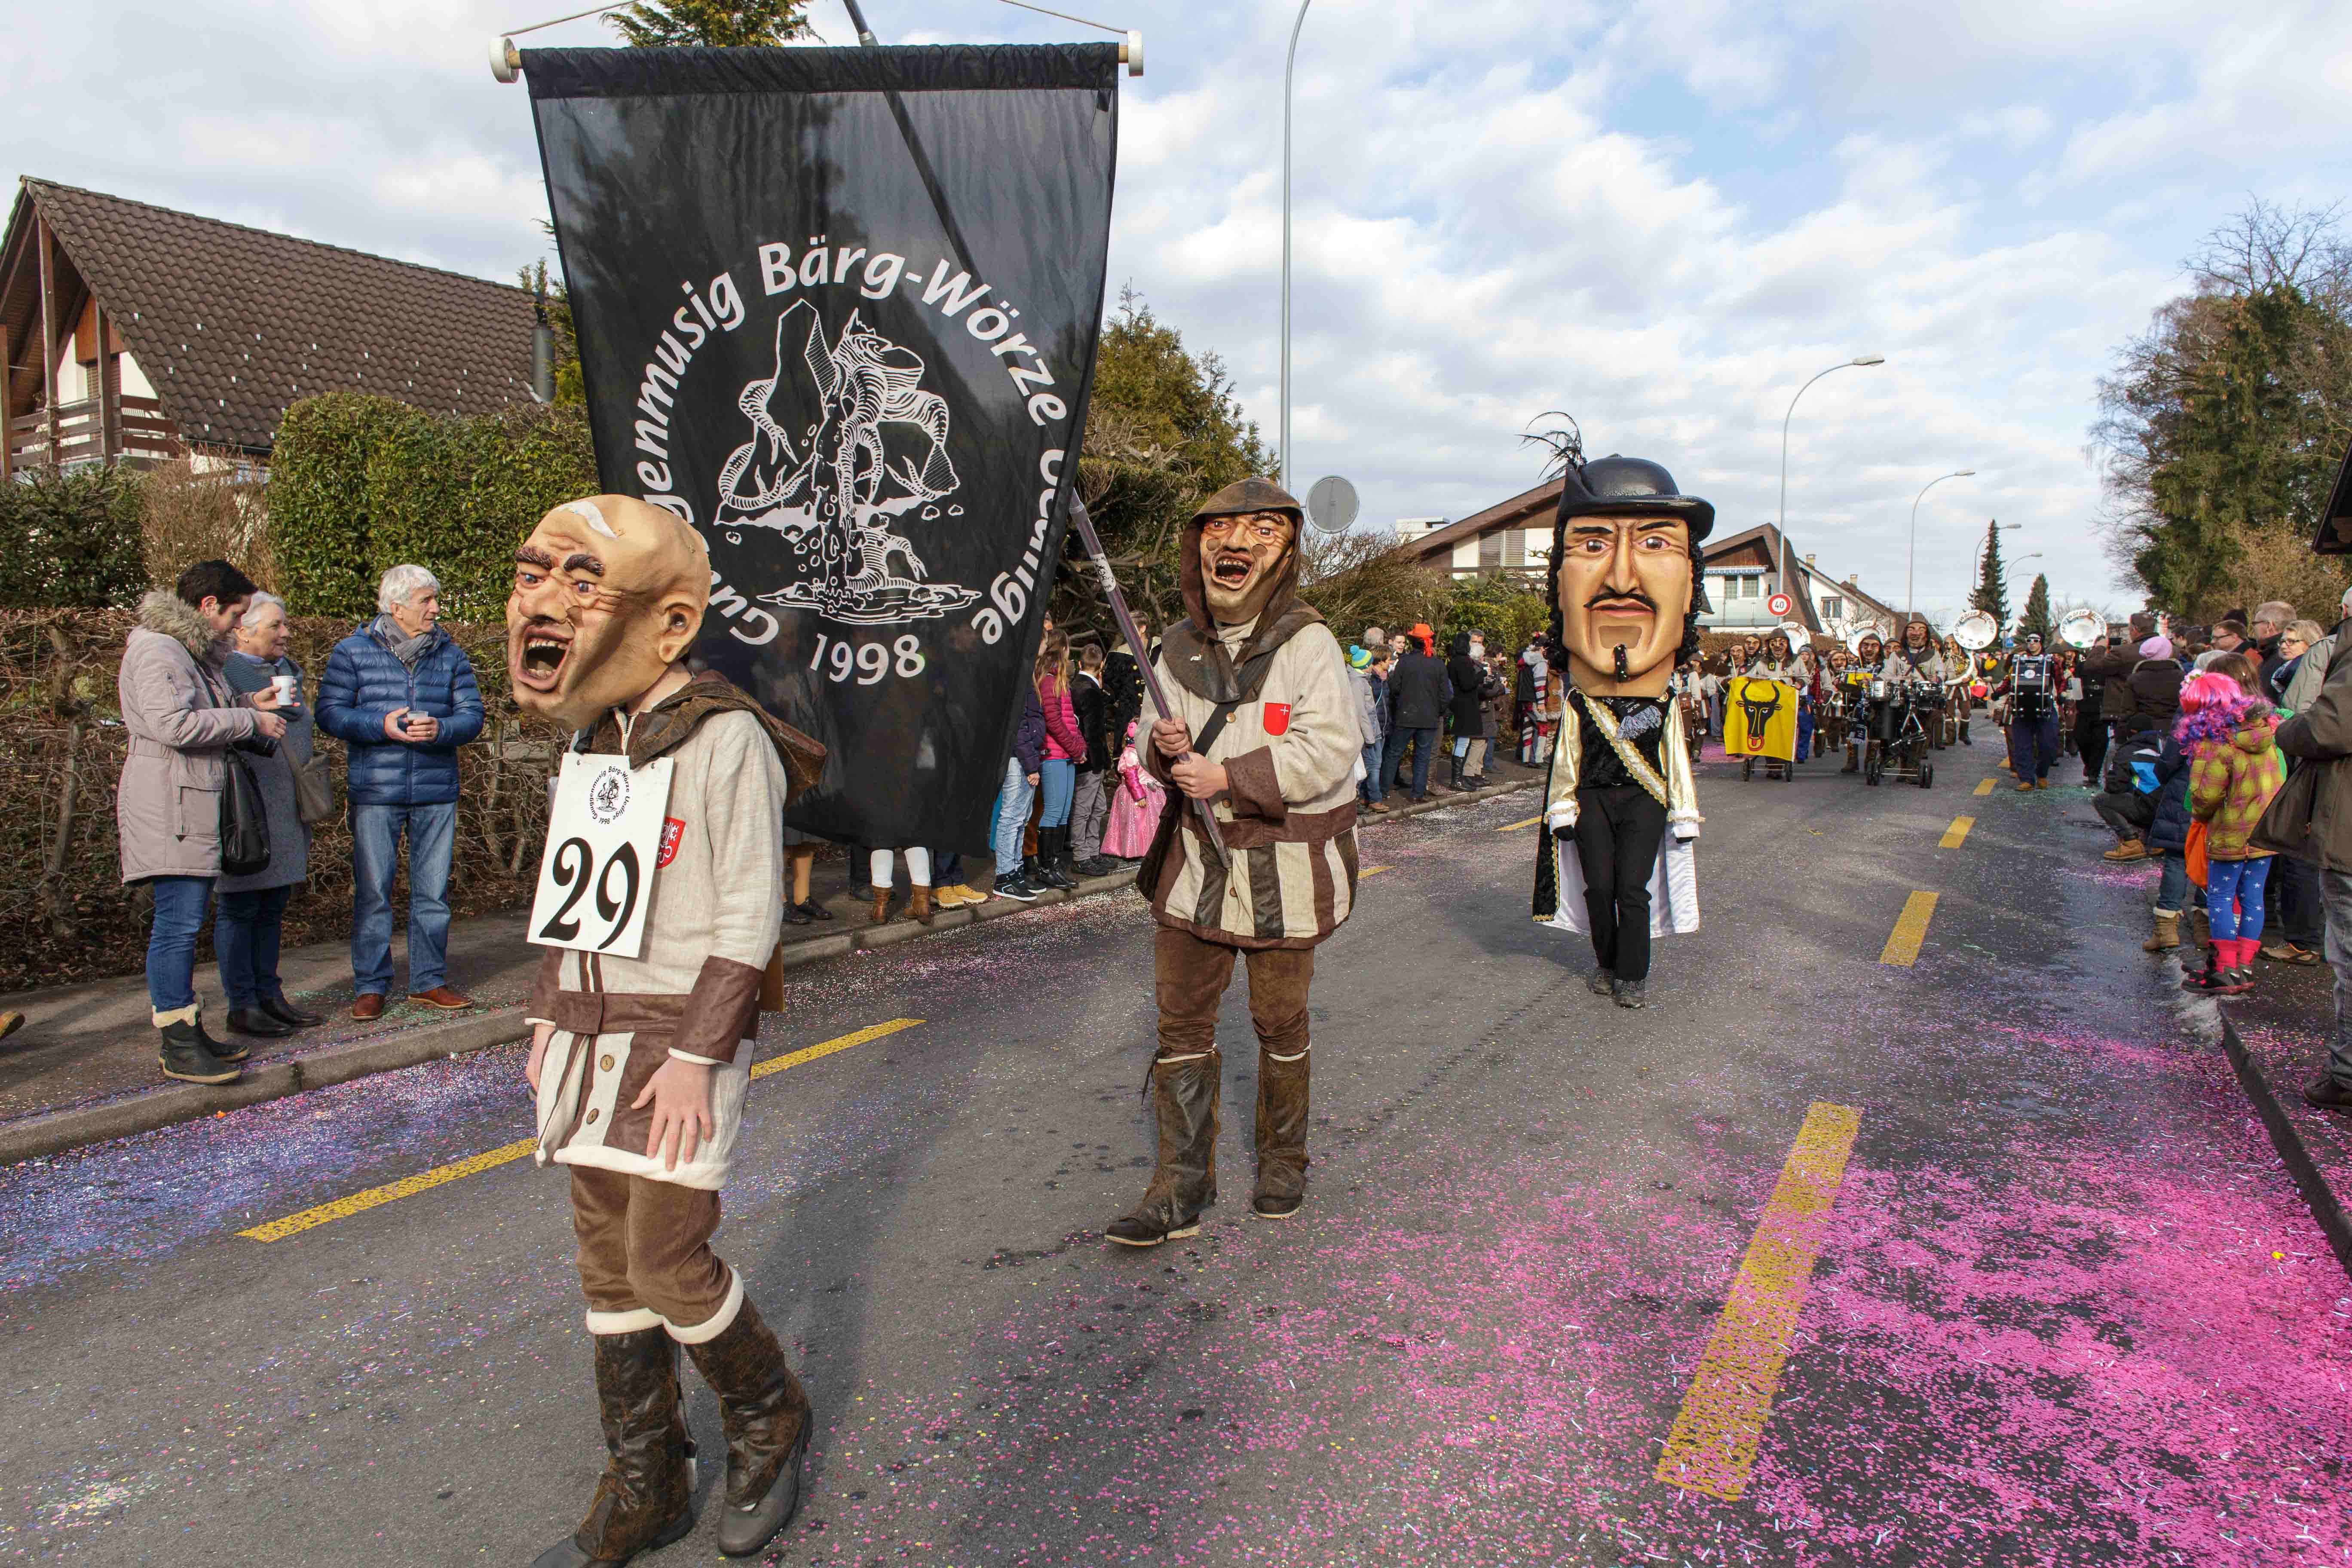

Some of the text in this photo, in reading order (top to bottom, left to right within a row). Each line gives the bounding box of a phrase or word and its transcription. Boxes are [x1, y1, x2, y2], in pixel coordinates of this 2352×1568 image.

[758, 235, 1067, 427] Bärg-Wörze
[1775, 601, 1784, 609] 40
[810, 633, 925, 685] 1998
[612, 796, 630, 820] Uedlige
[539, 837, 640, 950] 29
